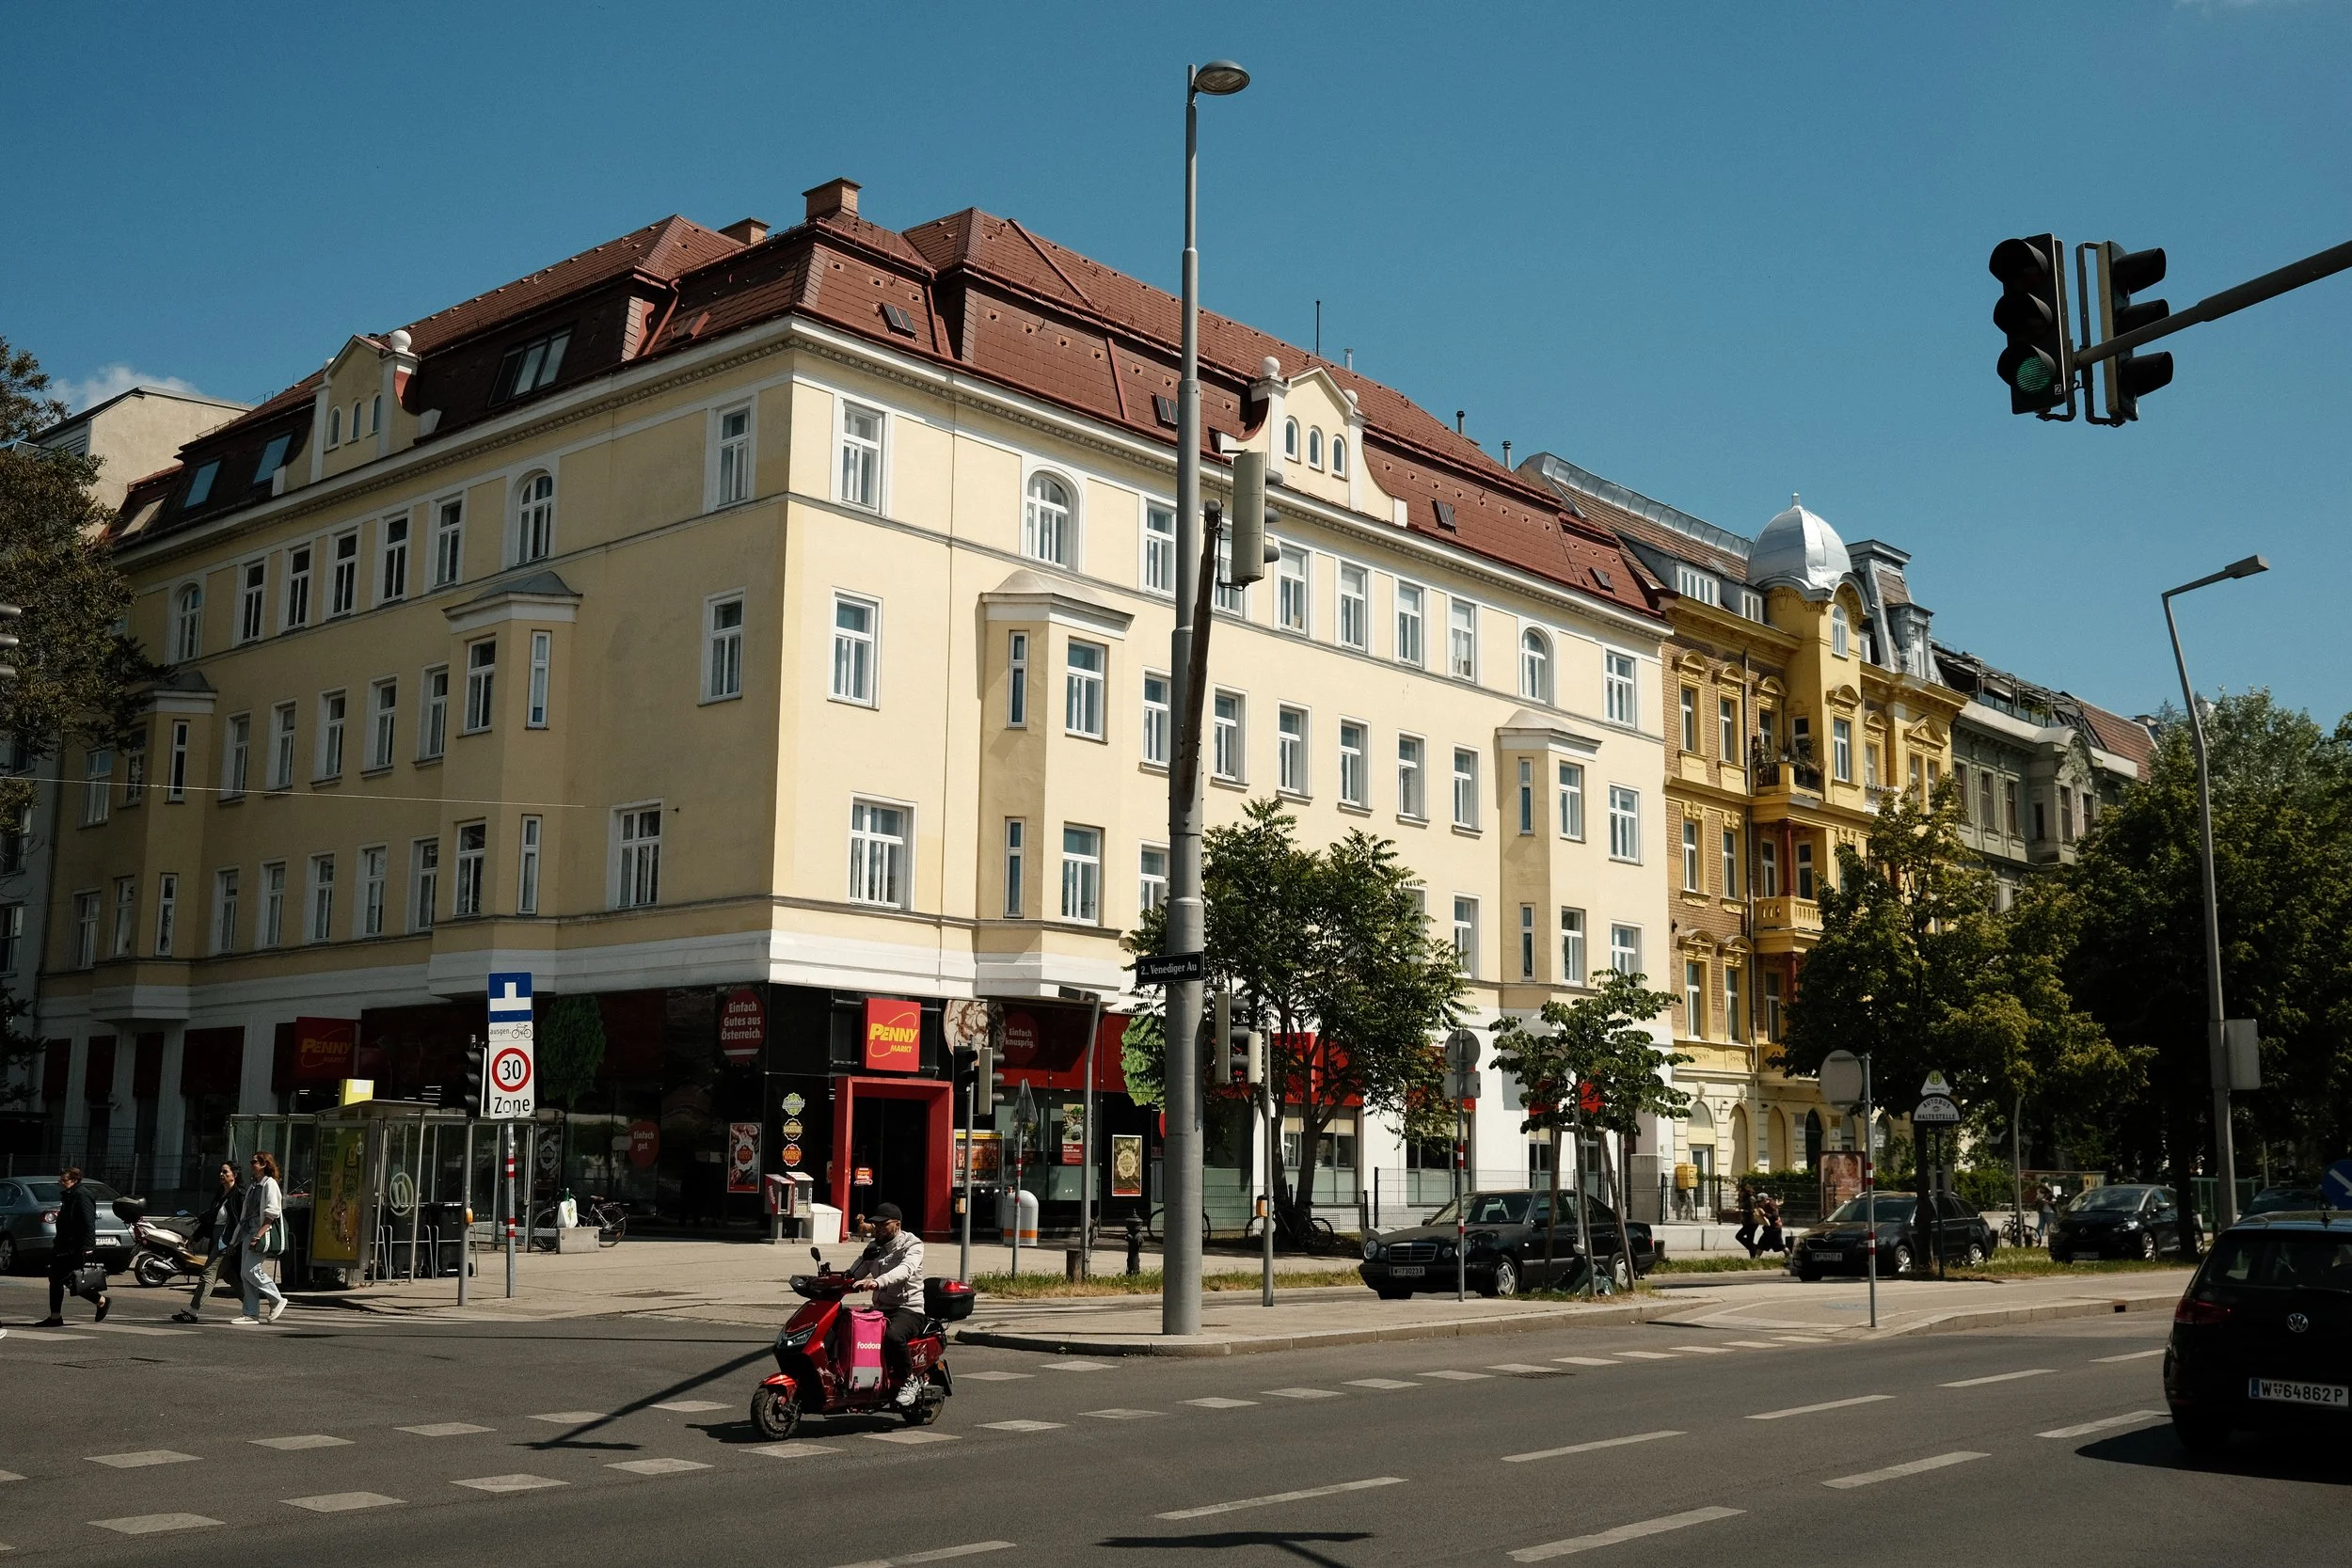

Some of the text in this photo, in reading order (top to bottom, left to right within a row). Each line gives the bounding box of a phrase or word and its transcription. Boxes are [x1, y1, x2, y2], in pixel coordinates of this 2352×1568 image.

[1150, 962, 1185, 975] Venediger
[1186, 960, 1198, 972] Au
[728, 1001, 757, 1013] Einfach
[723, 1016, 761, 1026] Gutes aus
[489, 1027, 511, 1037] ausgen.
[721, 1027, 763, 1040] Österreich.
[869, 1022, 918, 1043] PENNY
[1009, 1027, 1032, 1037] Einfach
[300, 1037, 353, 1054] PENNY
[889, 1044, 913, 1053] MARKT
[1005, 1037, 1036, 1049] knusprig.
[501, 1059, 522, 1081] 30
[494, 1096, 531, 1115] Zone
[1922, 1098, 1951, 1109] AUTOBUS
[633, 1130, 655, 1140] Einfach
[637, 1142, 649, 1152] gut.
[857, 1341, 882, 1350] foodora
